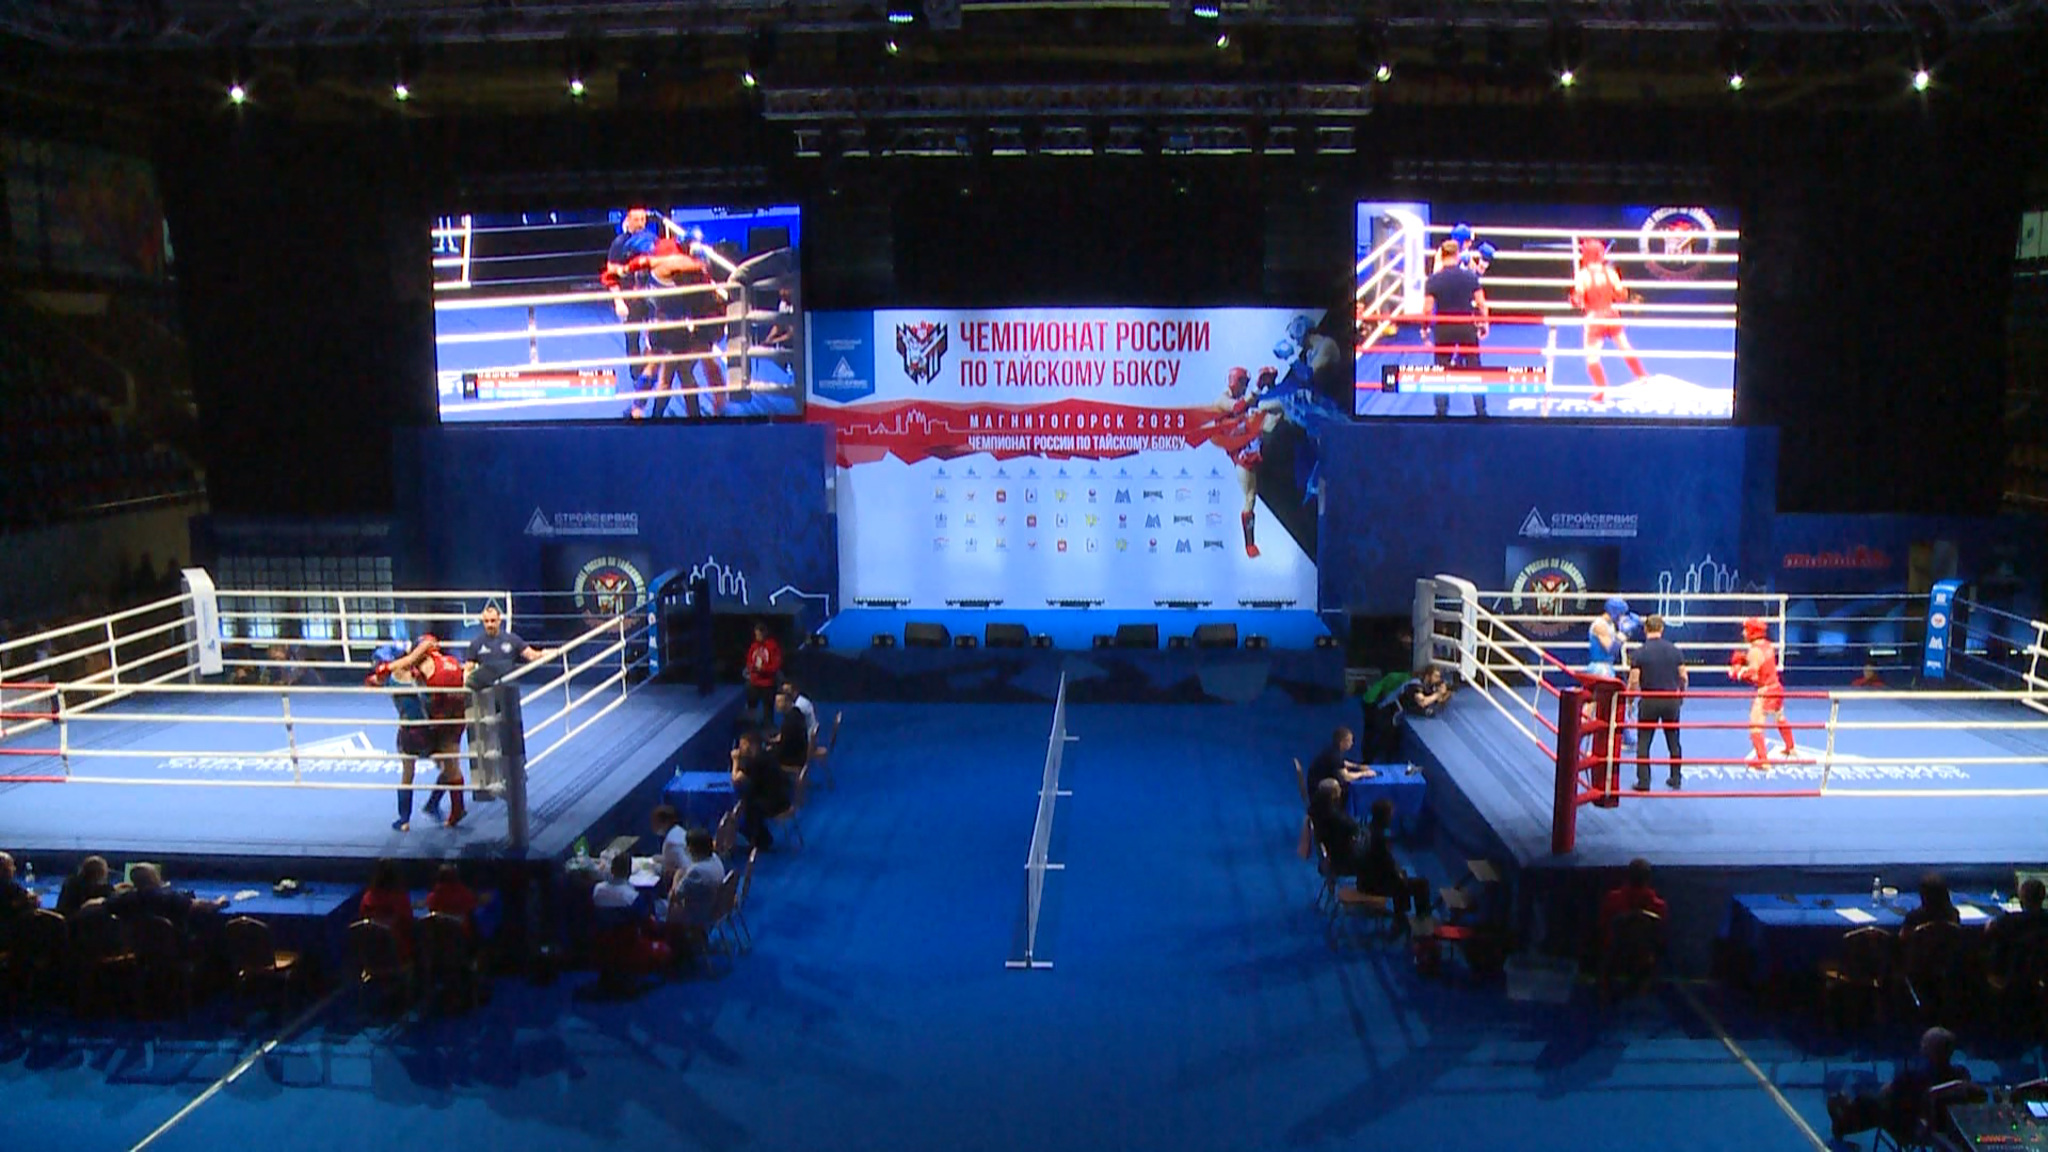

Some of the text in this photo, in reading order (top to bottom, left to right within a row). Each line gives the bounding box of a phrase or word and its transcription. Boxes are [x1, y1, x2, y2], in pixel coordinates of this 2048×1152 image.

[960, 321, 1210, 352] ЧЕМПИОНАТ РОССИИ
[960, 353, 1181, 387] ПО ТАЙСКОМУ БОКСУ
[969, 412, 1186, 428] МАГНИТОГОРСК 2023
[968, 433, 1186, 451] ЧЕМПИОНАТ РОССИИ ПО ТАЙСКОМУ БОКСУ
